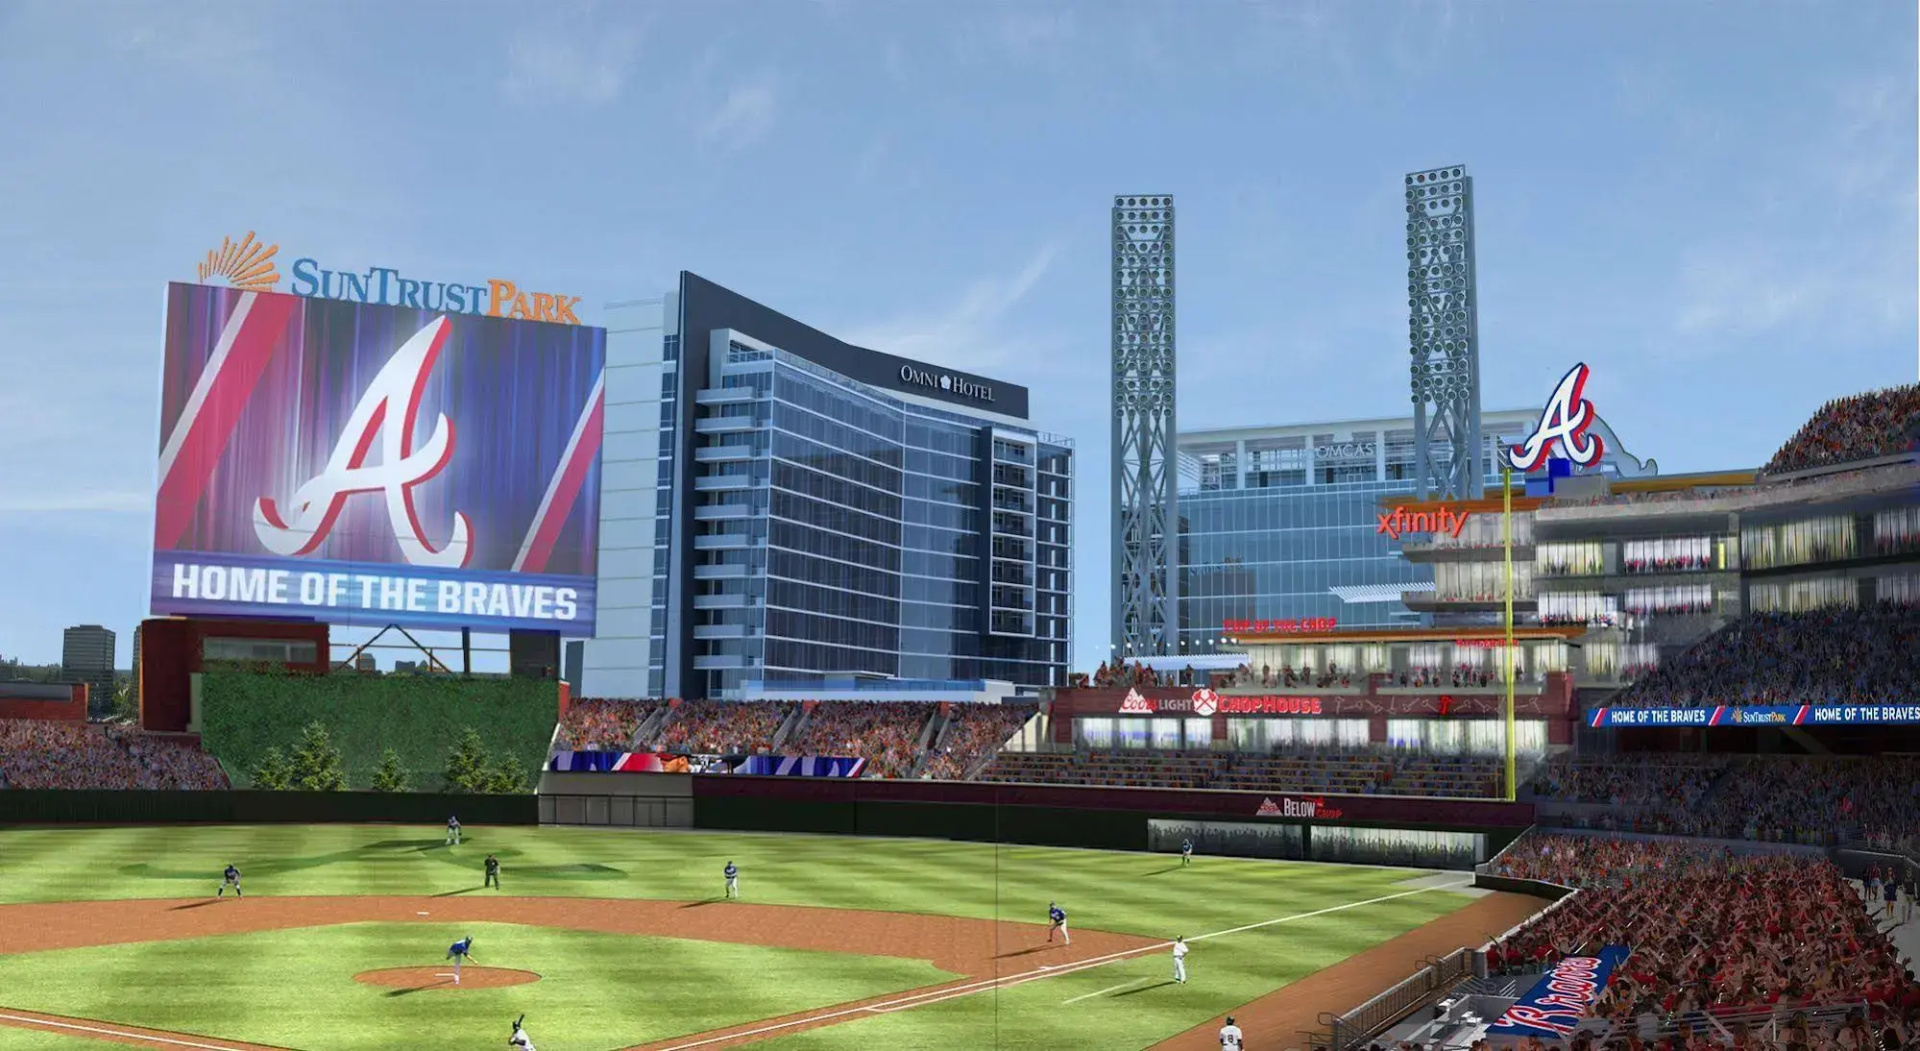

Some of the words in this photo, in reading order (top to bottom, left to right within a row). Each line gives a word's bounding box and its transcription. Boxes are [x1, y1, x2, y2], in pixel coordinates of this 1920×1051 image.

[900, 365, 938, 389] OMNI
[952, 376, 996, 402] HOTEL
[1376, 506, 1471, 540] xfinity
[172, 563, 290, 604] HOME
[300, 571, 351, 608] OF
[350, 574, 428, 613] THE
[437, 579, 578, 621] BRAVES
[1158, 698, 1193, 712] LIGHT
[1814, 707, 1842, 721] HOME
[1844, 707, 1857, 721] OF
[1859, 707, 1880, 721] THE
[1882, 706, 1920, 721] BRAVES
[1611, 710, 1636, 723] HOME
[1637, 710, 1649, 723] OF
[1651, 710, 1669, 723] THE
[1670, 709, 1706, 723] BRAVES
[1283, 797, 1316, 818] BELOW
